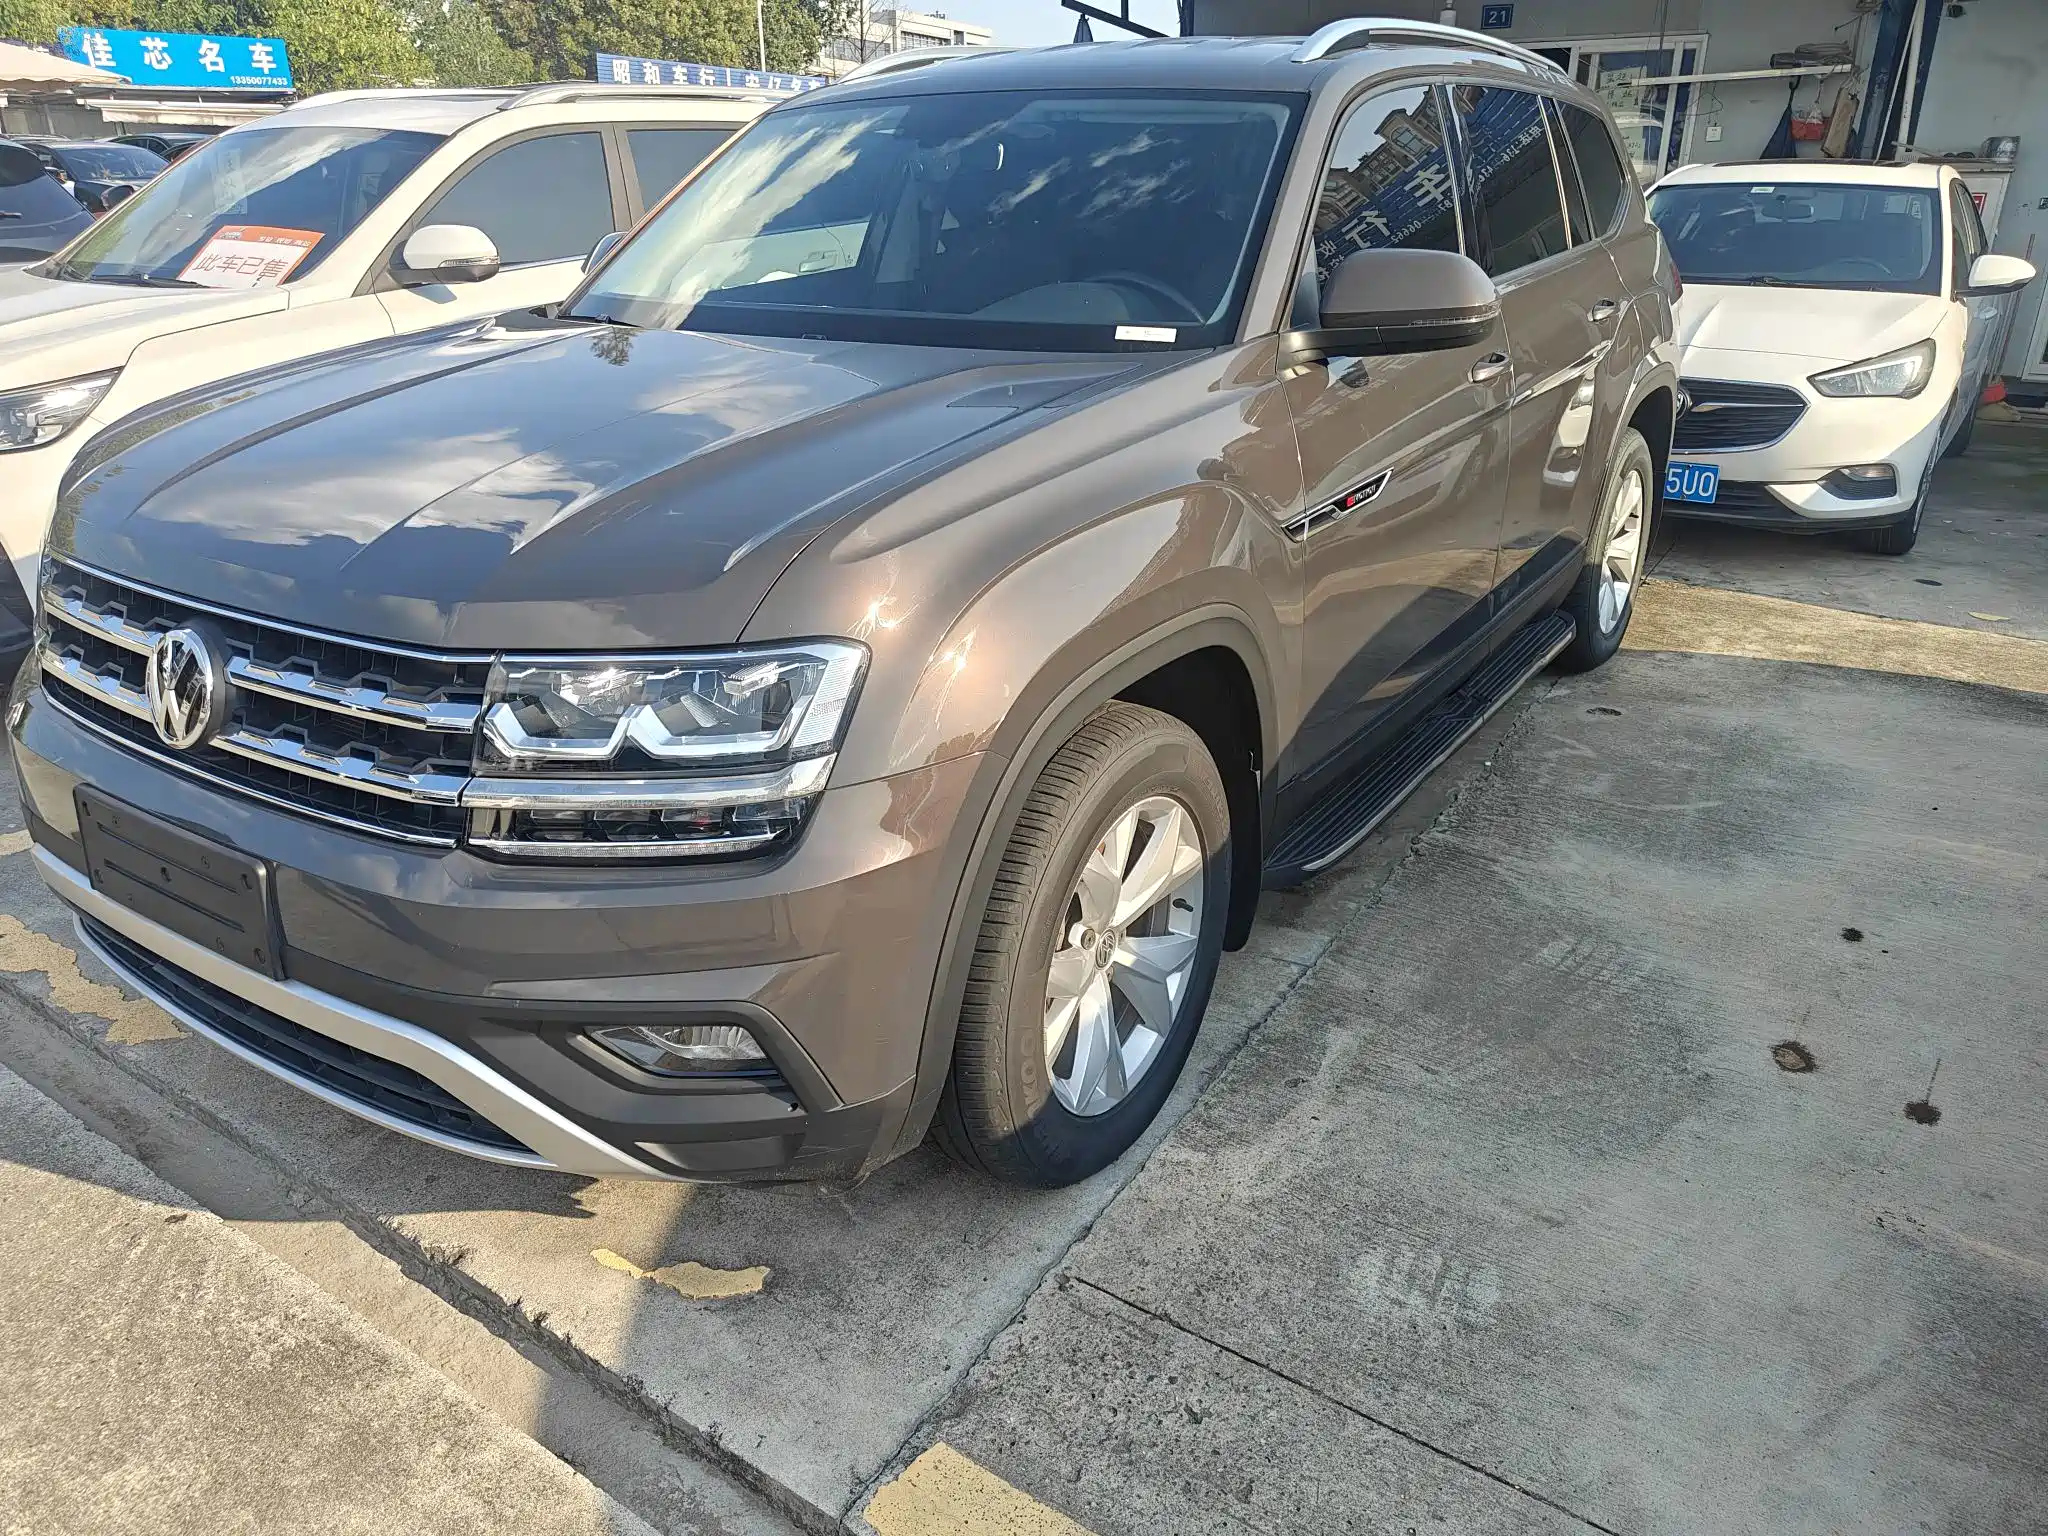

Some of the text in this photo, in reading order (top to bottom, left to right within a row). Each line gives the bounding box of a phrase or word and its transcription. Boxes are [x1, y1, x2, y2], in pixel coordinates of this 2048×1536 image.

[1488, 10, 1506, 23] 21
[82, 33, 277, 74] 佳芯名车
[192, 255, 289, 279] 此车已售
